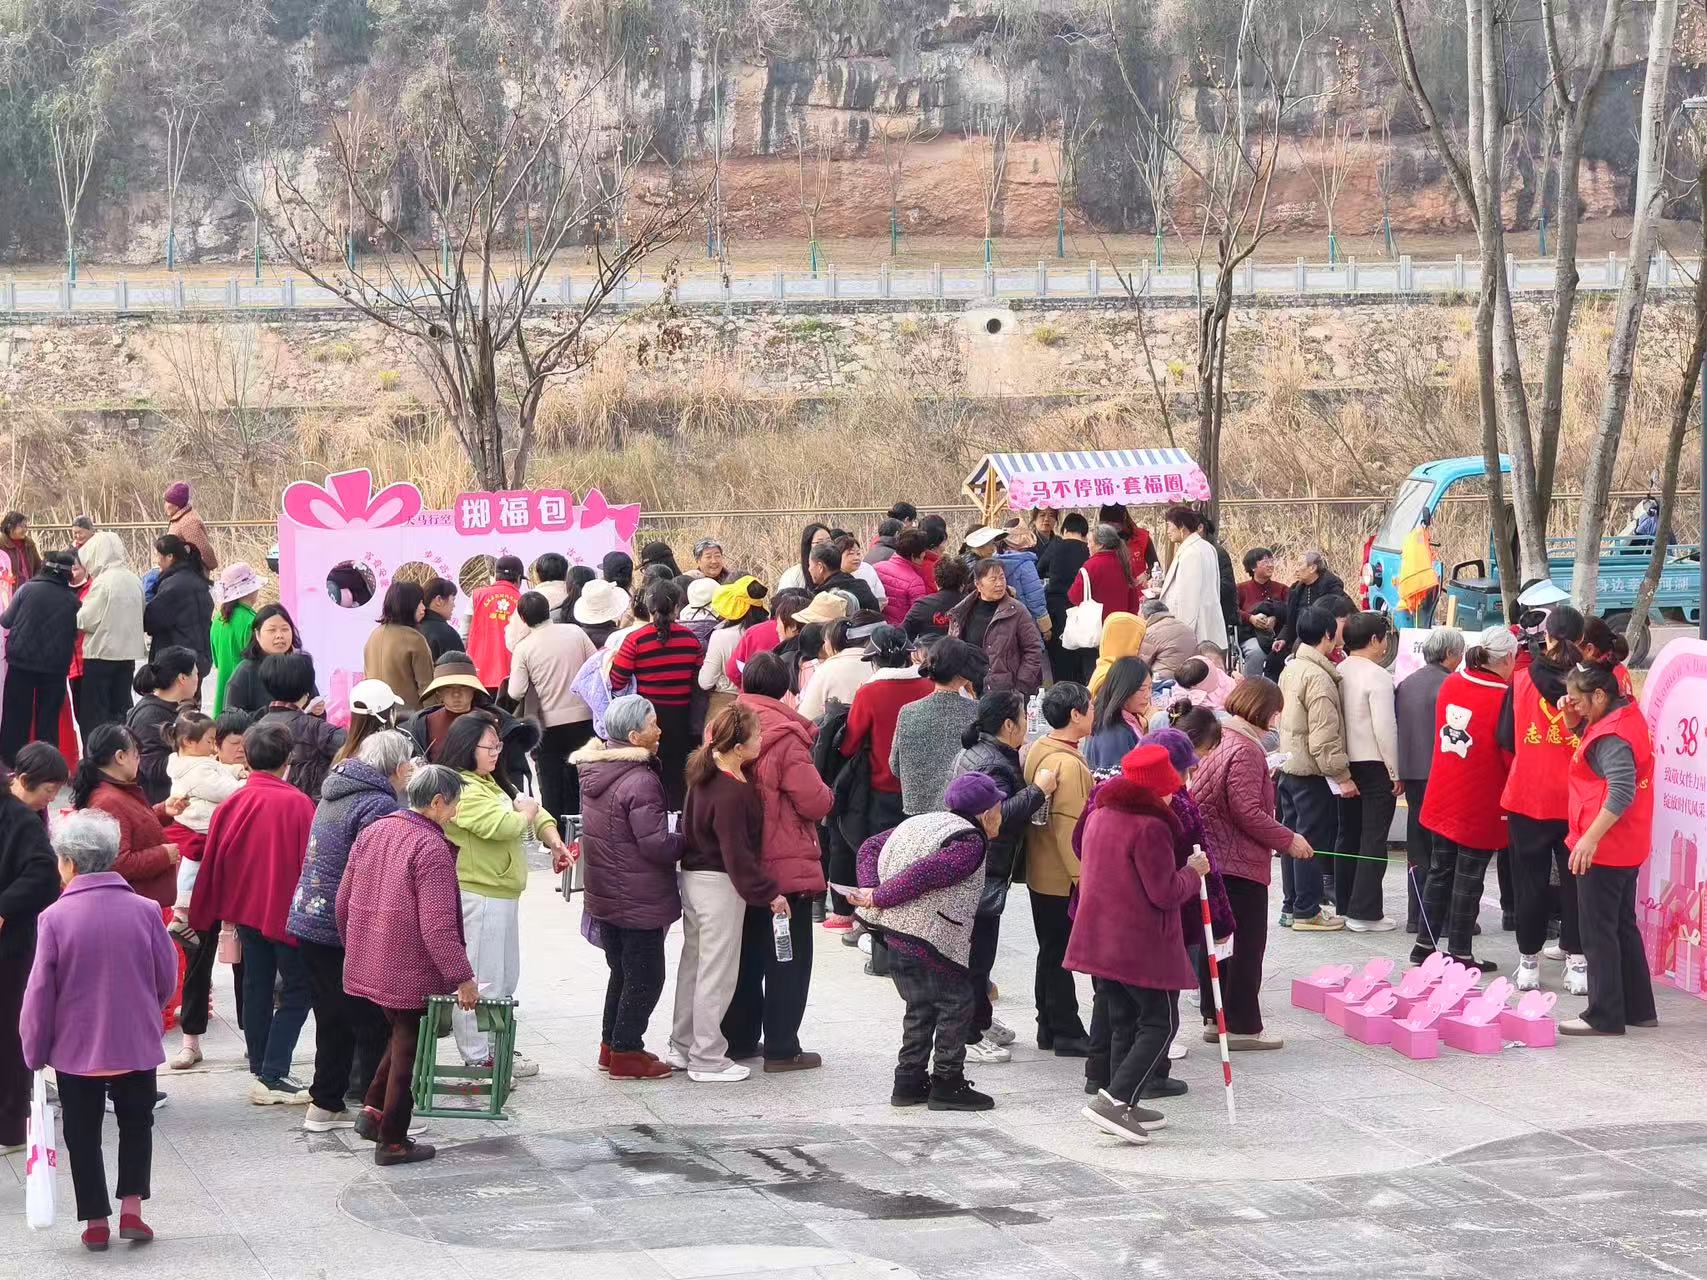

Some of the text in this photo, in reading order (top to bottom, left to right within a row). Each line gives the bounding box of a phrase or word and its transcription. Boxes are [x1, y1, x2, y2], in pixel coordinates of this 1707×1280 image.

[1032, 473, 1183, 500] 马不停蹄·套福圈
[461, 495, 567, 529] 掷福包
[1523, 721, 1581, 748] 志愿者
[1675, 716, 1699, 757] 38
